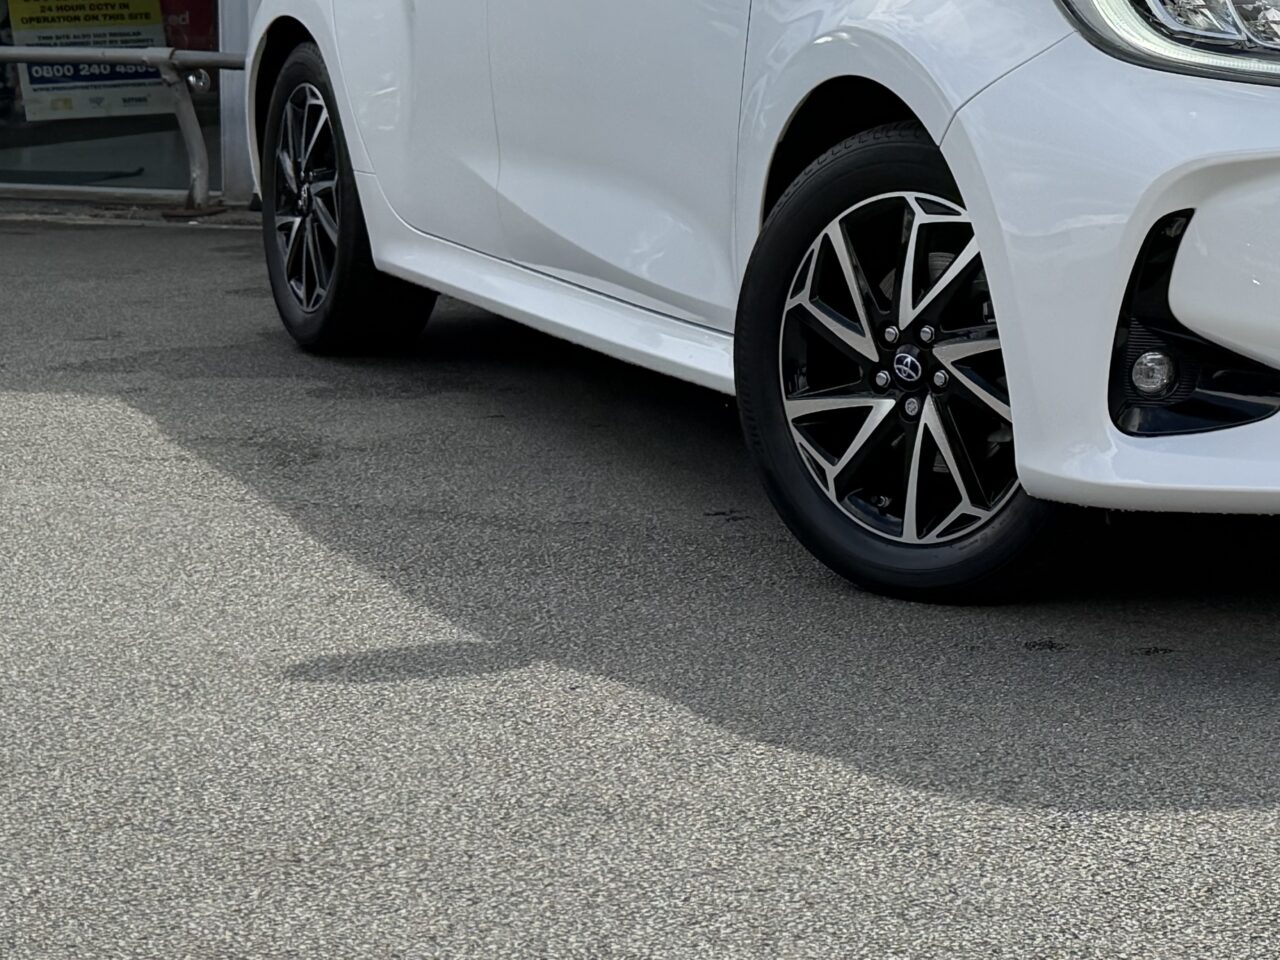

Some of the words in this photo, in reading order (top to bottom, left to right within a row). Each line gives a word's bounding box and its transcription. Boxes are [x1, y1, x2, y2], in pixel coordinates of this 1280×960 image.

[40, 4, 52, 14] 24
[55, 3, 86, 13] HOUR
[89, 2, 116, 11] CCTV
[20, 15, 81, 25] OPERATION
[84, 14, 99, 23] ON
[101, 13, 126, 22] THIS
[128, 12, 152, 21] SITE
[31, 65, 74, 77] 0800
[79, 64, 110, 76] 240
